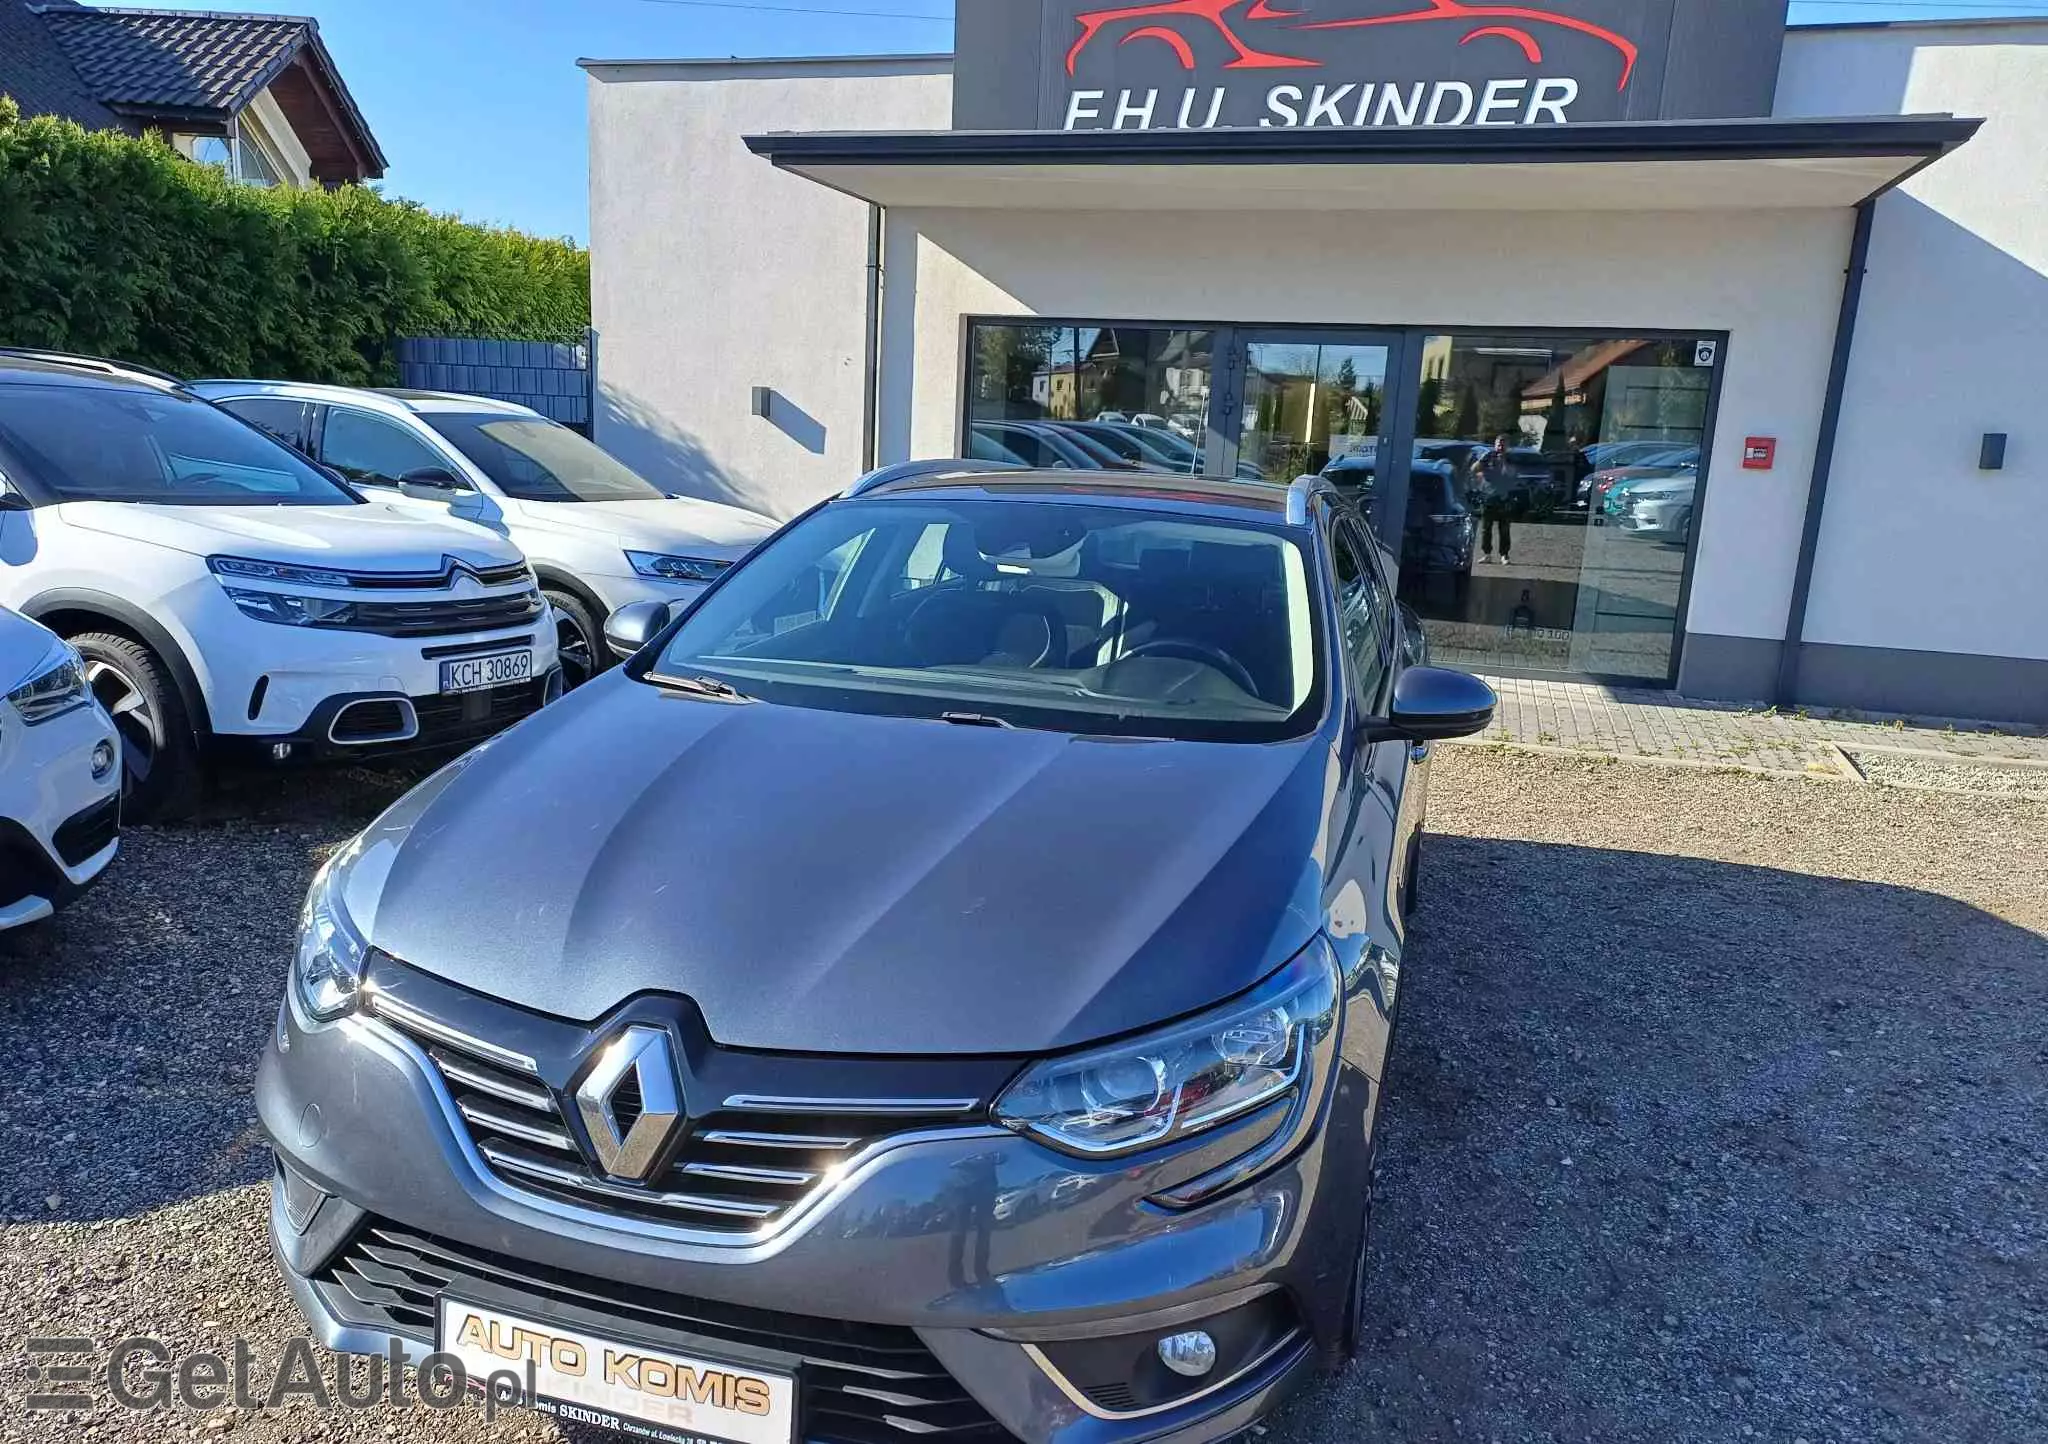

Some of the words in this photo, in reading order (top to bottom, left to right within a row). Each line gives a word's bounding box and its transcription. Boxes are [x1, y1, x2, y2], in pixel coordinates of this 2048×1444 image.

[1259, 78, 1579, 127] SKINDER
[451, 663, 481, 687] KCH
[487, 655, 529, 681] 30869
[456, 1314, 587, 1377] AUTO
[603, 1349, 770, 1416] KOMIS
[559, 1404, 620, 1430] SKINDER
